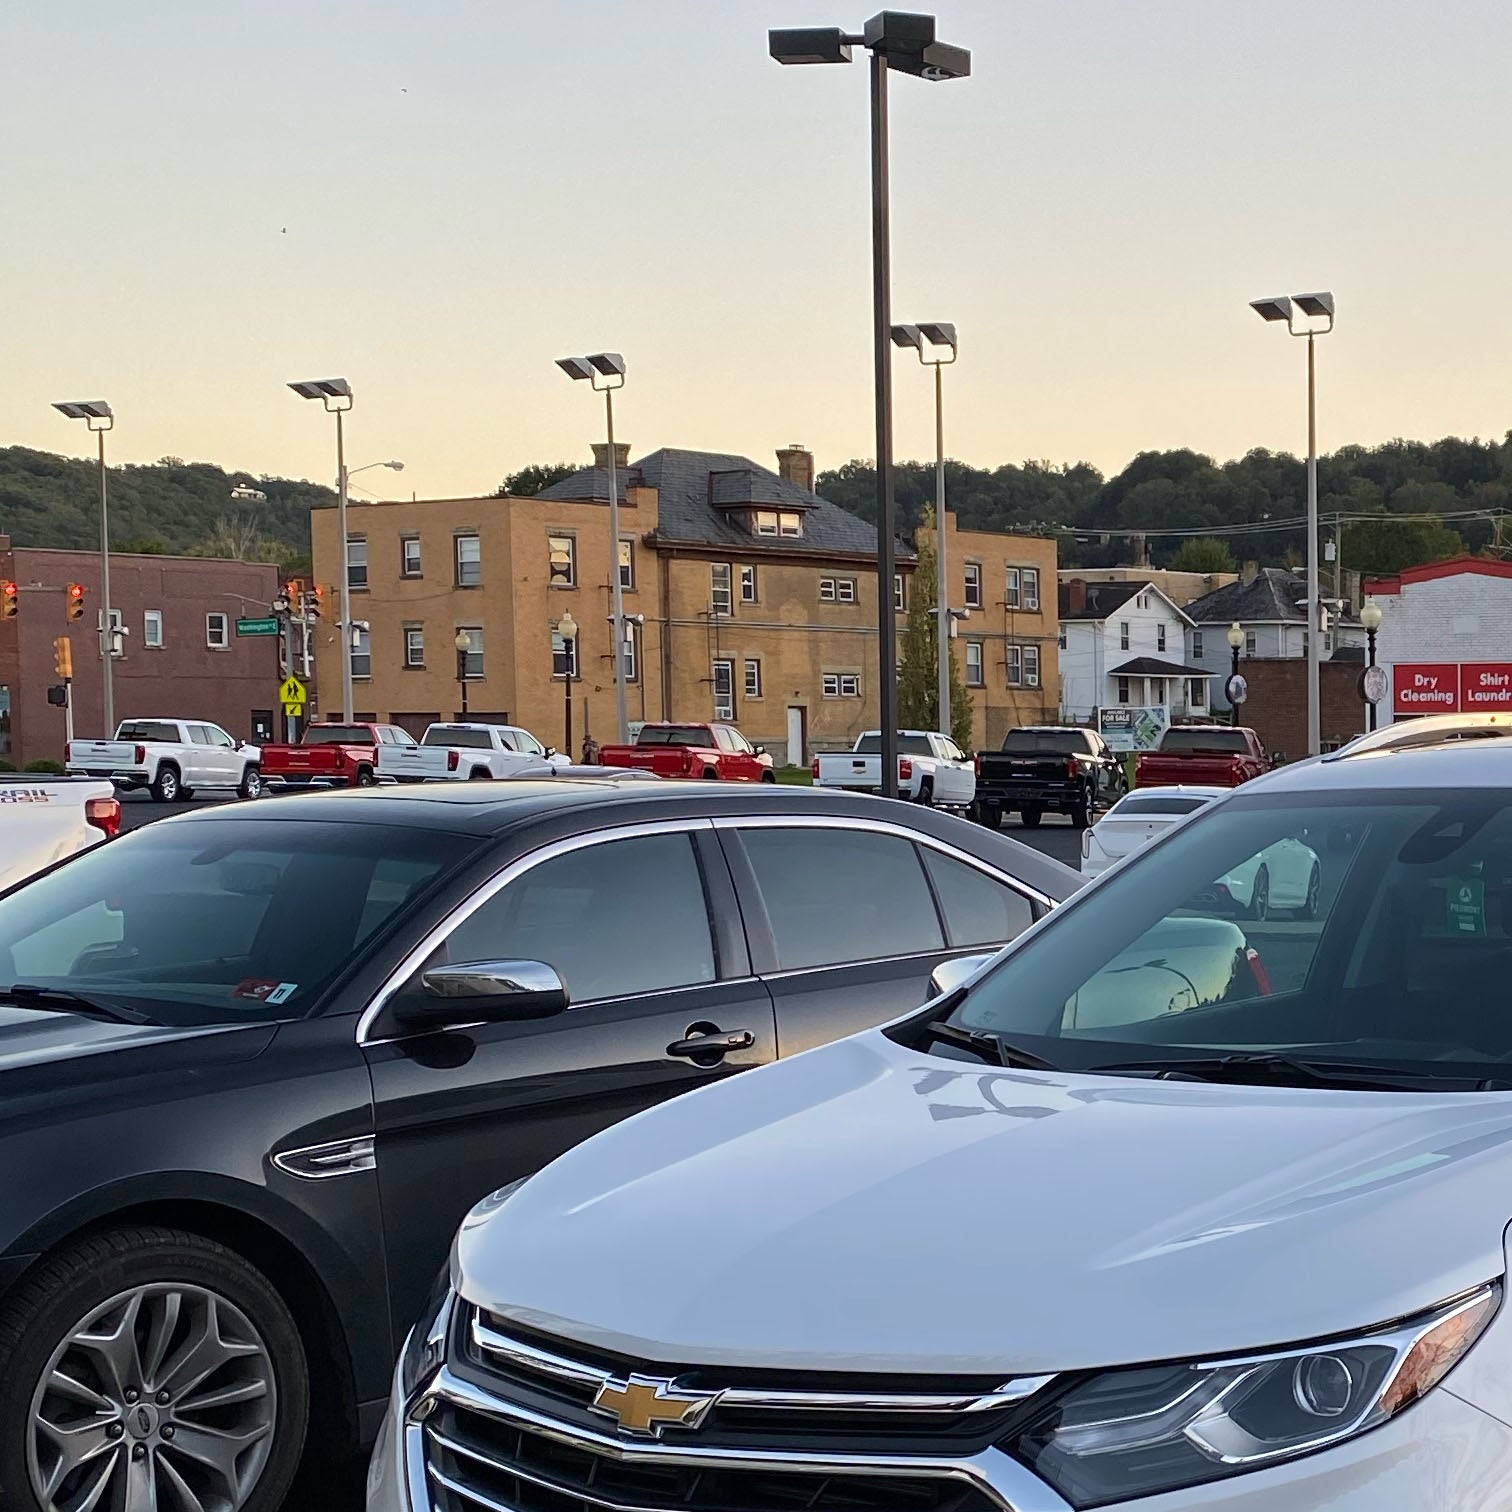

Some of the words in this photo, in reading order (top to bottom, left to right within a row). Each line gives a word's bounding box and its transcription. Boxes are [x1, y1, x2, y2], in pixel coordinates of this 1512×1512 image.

[1414, 674, 1438, 689] Dry
[1480, 673, 1509, 686] Shirt
[1400, 690, 1454, 705] Cleaning
